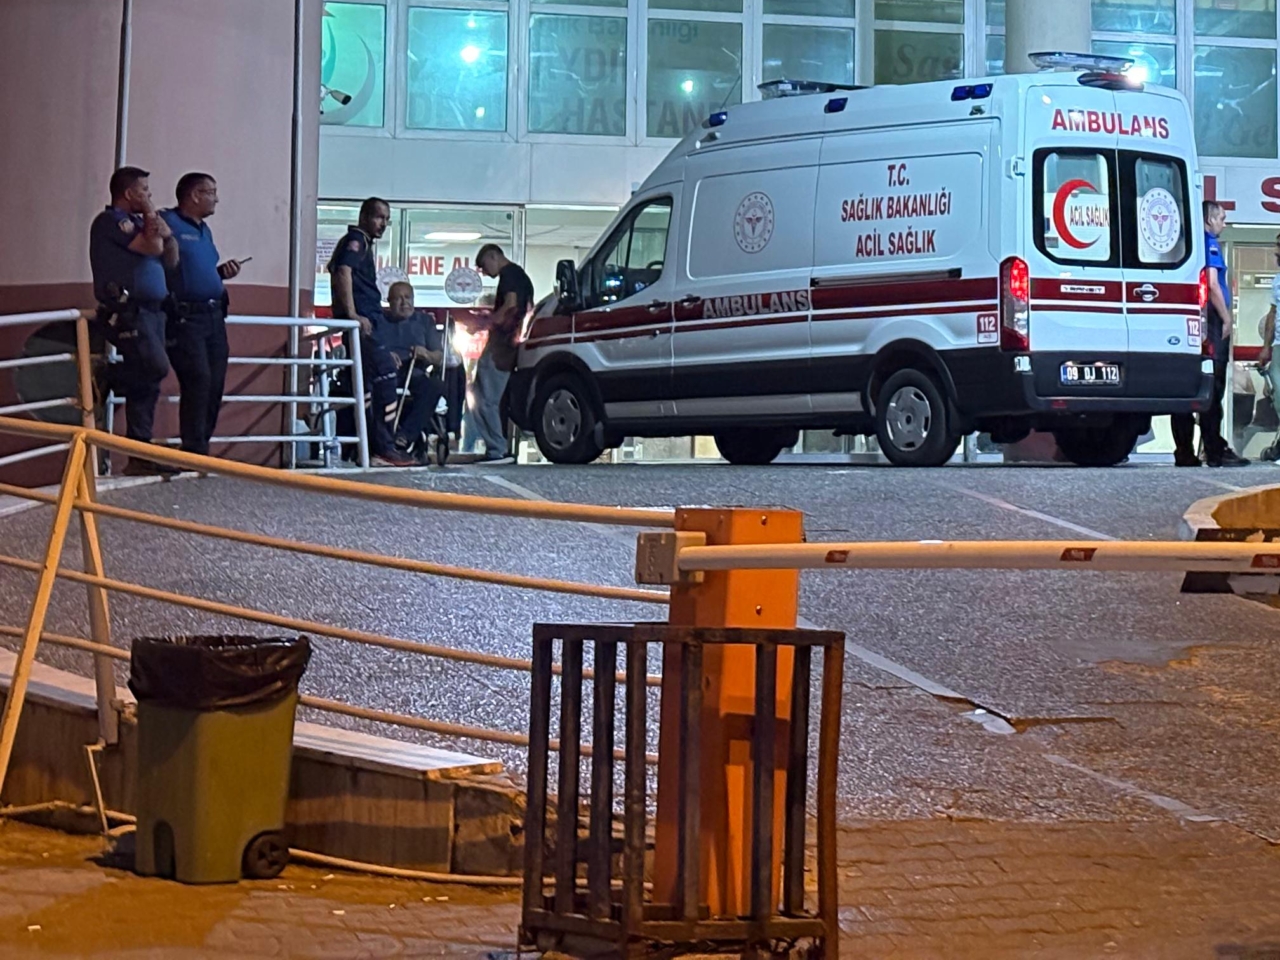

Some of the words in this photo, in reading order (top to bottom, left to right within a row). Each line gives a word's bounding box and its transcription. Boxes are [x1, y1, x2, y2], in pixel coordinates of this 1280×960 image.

[1051, 108, 1170, 140] AMBULANS
[887, 162, 910, 188] T.C.
[841, 193, 884, 223] SAĞLIK
[886, 186, 952, 219] BAKANLIĞI
[1086, 203, 1109, 228] SAĞLIK
[855, 227, 885, 258] ACİL
[887, 225, 937, 256] SAĞLIK
[702, 290, 811, 319] AMBULANS
[980, 316, 996, 331] 112
[1189, 320, 1199, 335] 112
[1066, 366, 1078, 380] 09
[1084, 366, 1096, 380] DJ
[1101, 366, 1117, 380] 112
